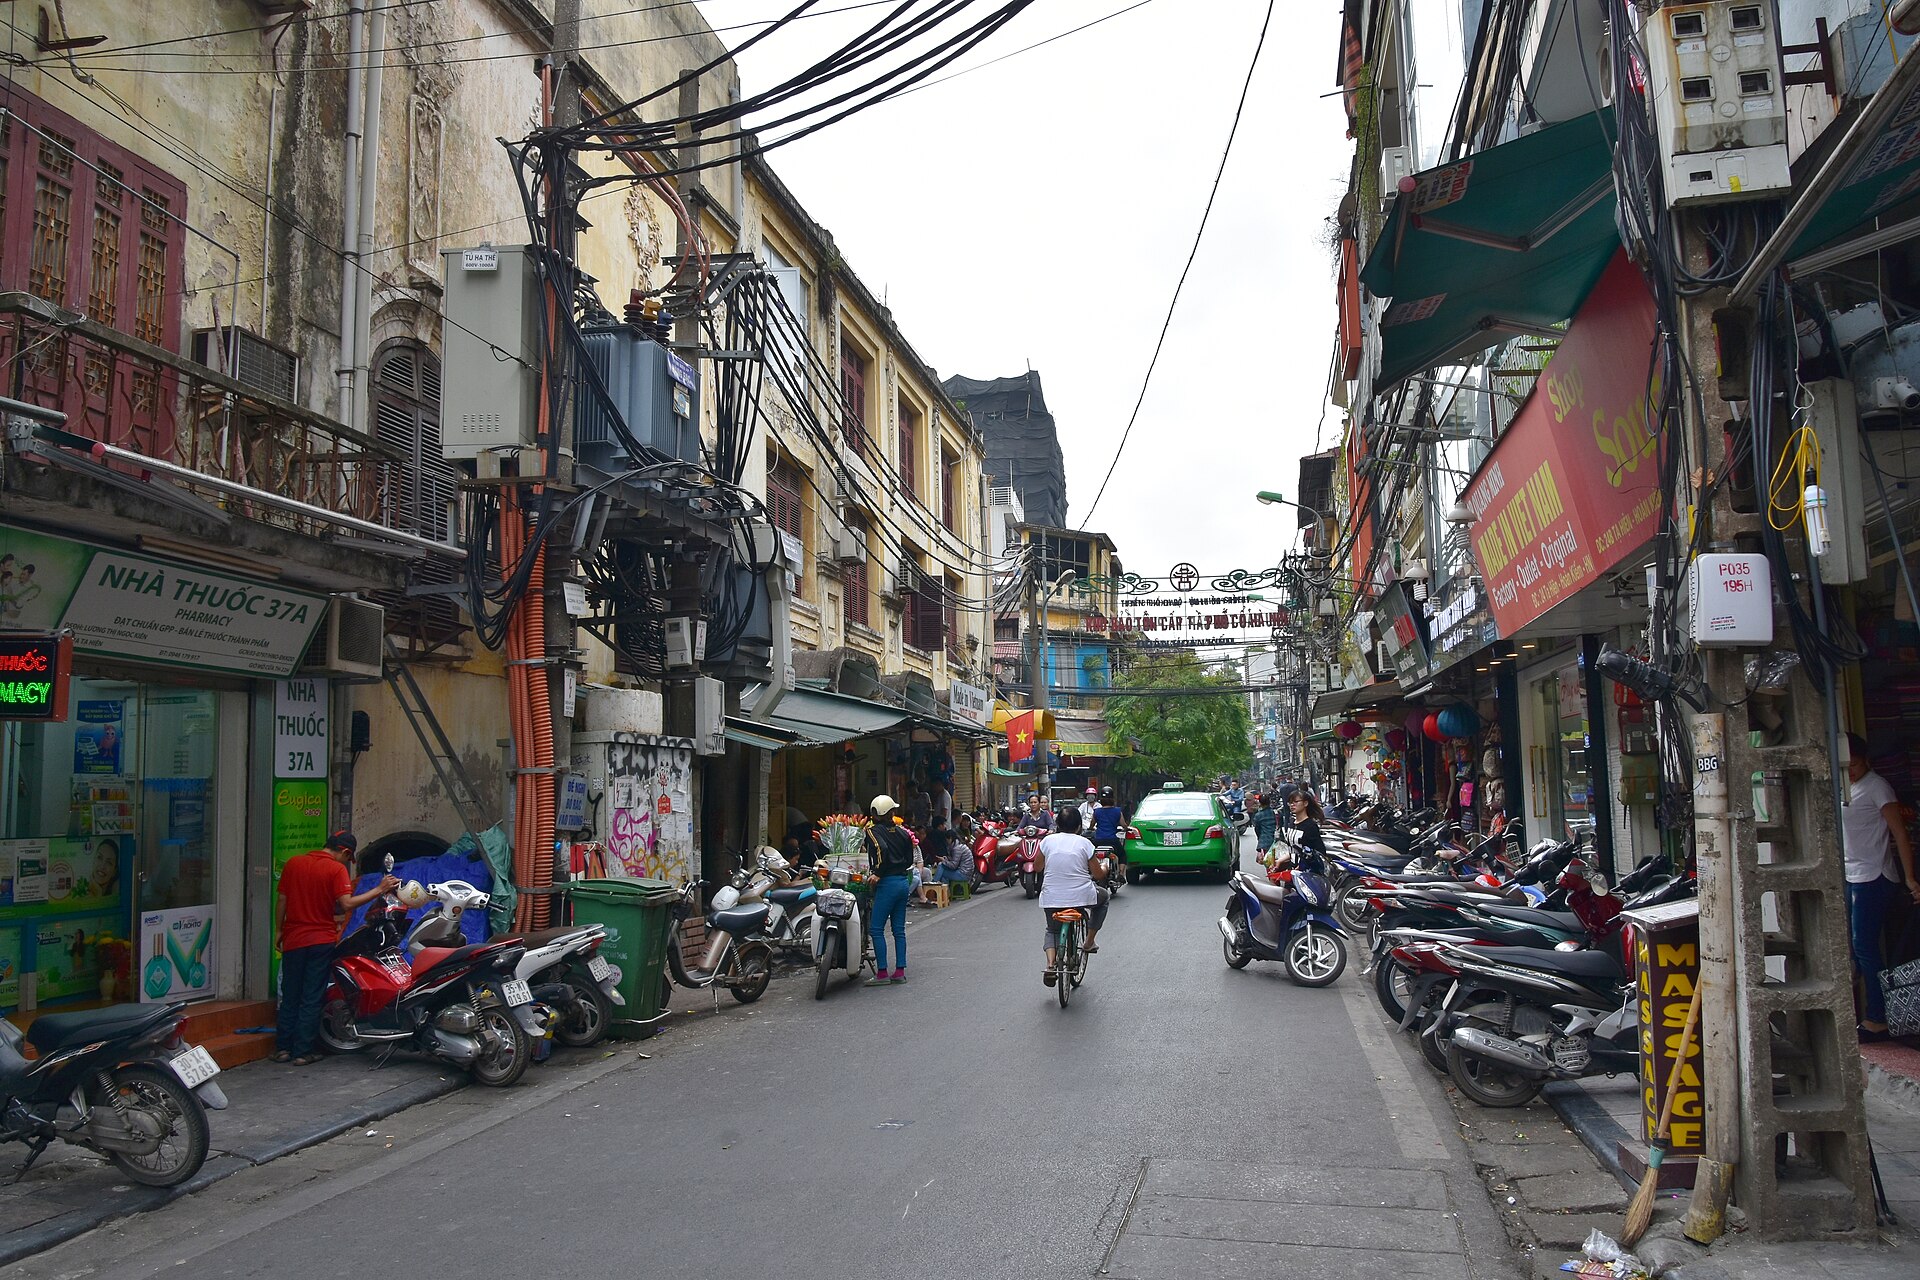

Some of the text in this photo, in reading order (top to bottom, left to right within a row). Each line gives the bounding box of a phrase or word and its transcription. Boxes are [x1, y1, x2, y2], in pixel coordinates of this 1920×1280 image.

[1477, 519, 1509, 581] MADE
[1497, 508, 1520, 561] IN
[1525, 459, 1565, 532] NAM
[1491, 520, 1578, 610] Factory Outlet Original
[1719, 563, 1751, 576] P035
[98, 564, 309, 624] NHÀ THUỐC 37A
[1722, 579, 1753, 592] 195H
[160, 624, 175, 634] GPP
[175, 608, 233, 627] PHARMACY
[287, 680, 317, 703] NHÀ
[277, 711, 325, 738] THUỐC
[287, 751, 314, 772] 37A
[1697, 756, 1718, 772] BBG
[277, 789, 322, 810] Eugica
[1638, 940, 1658, 1141] MASSAGE
[1656, 943, 1702, 1148] MASSAGE
[185, 1061, 215, 1084] 5789
